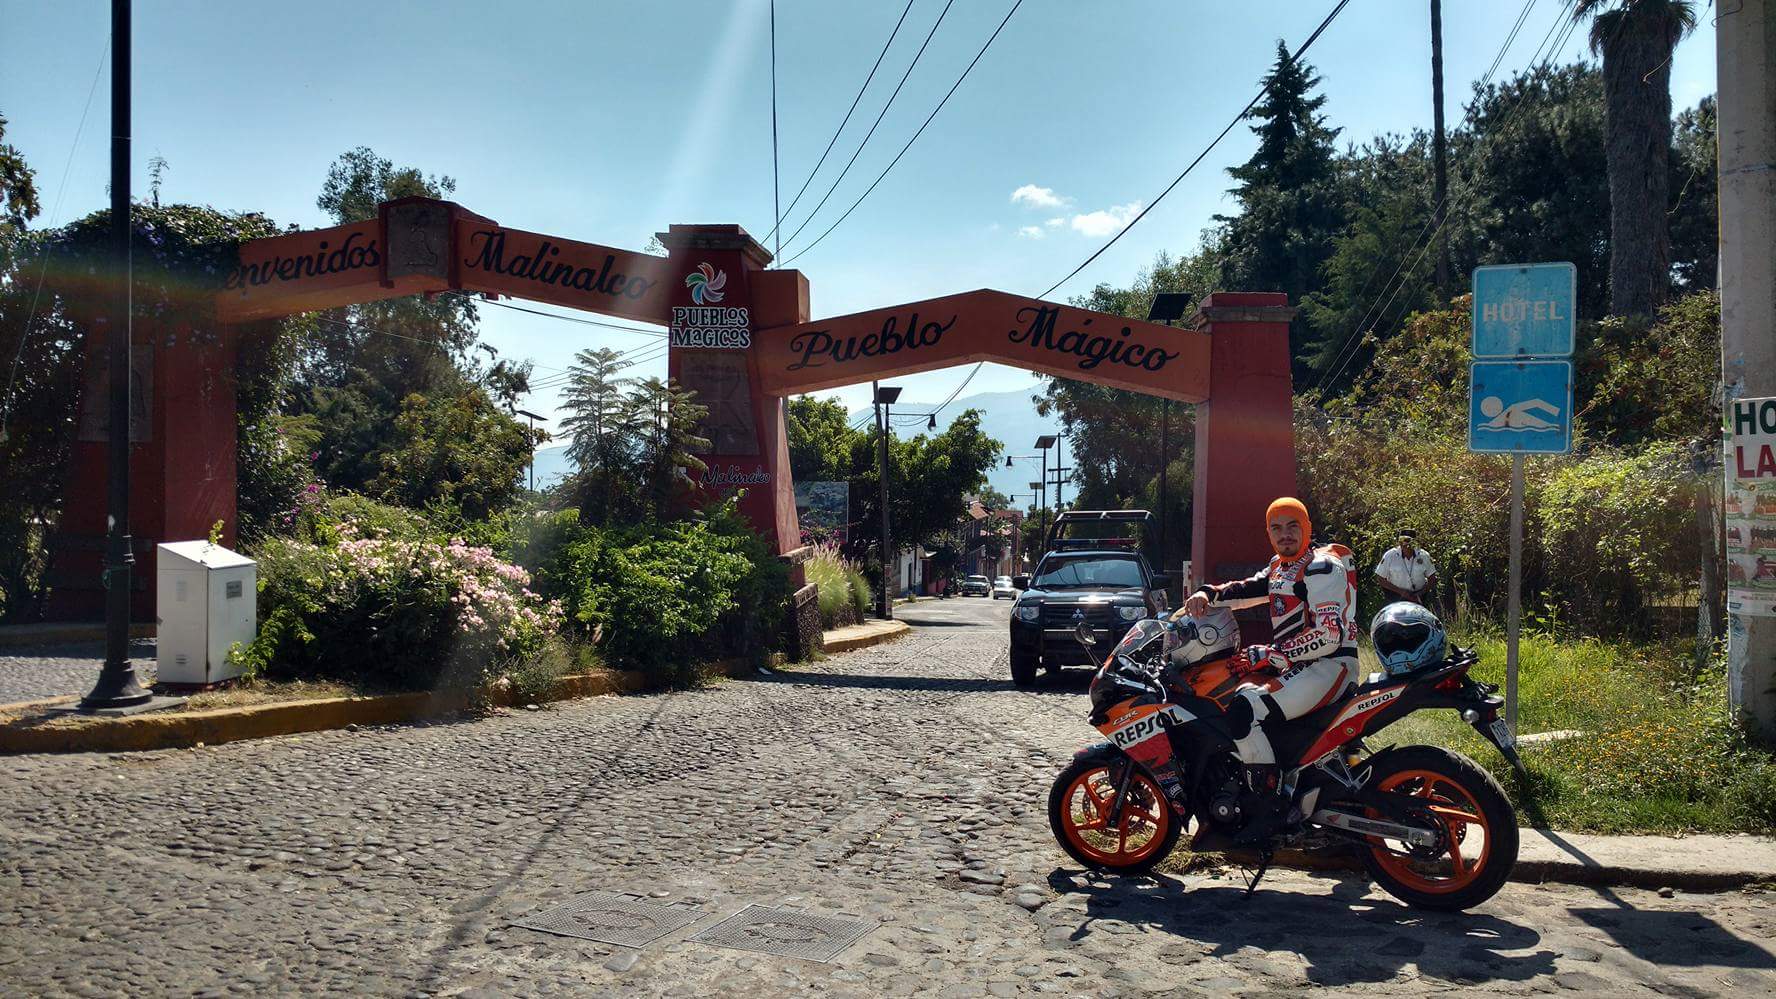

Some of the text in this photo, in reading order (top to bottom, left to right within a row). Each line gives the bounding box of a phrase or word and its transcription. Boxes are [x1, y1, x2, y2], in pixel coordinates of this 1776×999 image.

[225, 230, 657, 299] envenidos Malinalco
[672, 306, 749, 328] PUEBLOS
[1483, 300, 1564, 321] HOTEL
[786, 306, 1180, 371] Pueblo Mágico
[1734, 401, 1776, 435] HO
[1736, 444, 1776, 478] LA
[1282, 638, 1328, 659] REPSOL
[1357, 692, 1395, 711] REPSOL
[1114, 708, 1183, 747] REPSOL
